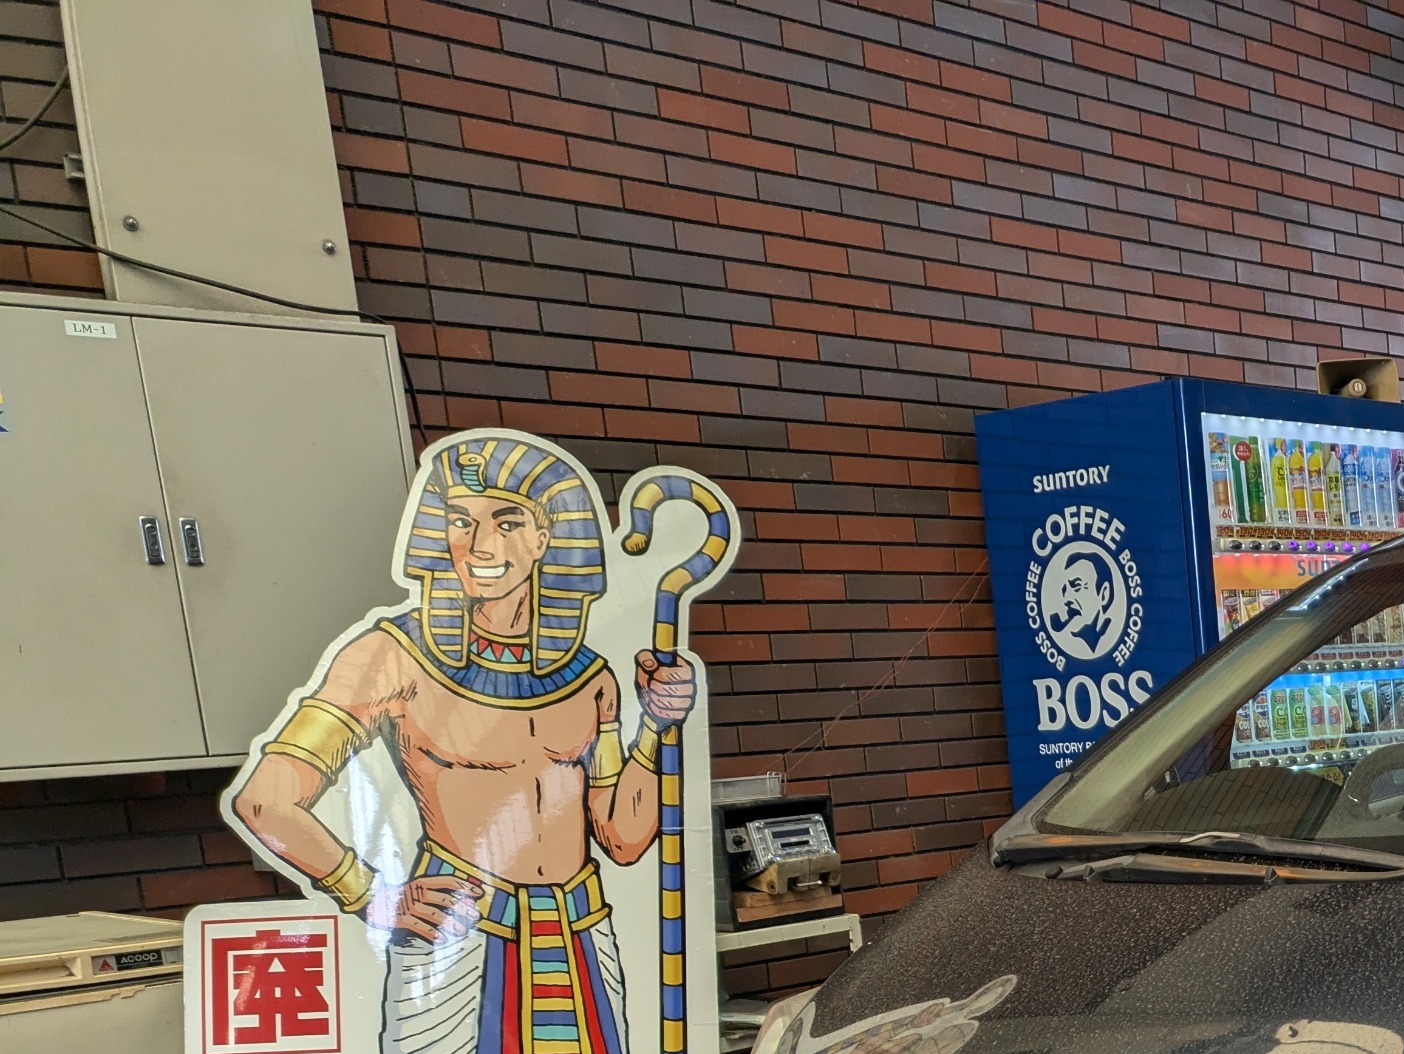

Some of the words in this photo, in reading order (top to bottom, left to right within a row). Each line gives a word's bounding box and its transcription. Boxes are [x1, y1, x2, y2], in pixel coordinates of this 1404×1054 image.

[72, 323, 107, 335] LM-1
[1033, 465, 1110, 493] SUNTORY
[1032, 505, 1126, 557] COFFEE
[1025, 560, 1042, 630] COFFEE
[1118, 548, 1143, 599] BOSS
[1034, 631, 1067, 672] BOSS
[1112, 602, 1143, 667] COFFEE
[1032, 670, 1153, 731] BOSS
[1039, 742, 1083, 755] SUNTORY
[1055, 758, 1064, 769] of
